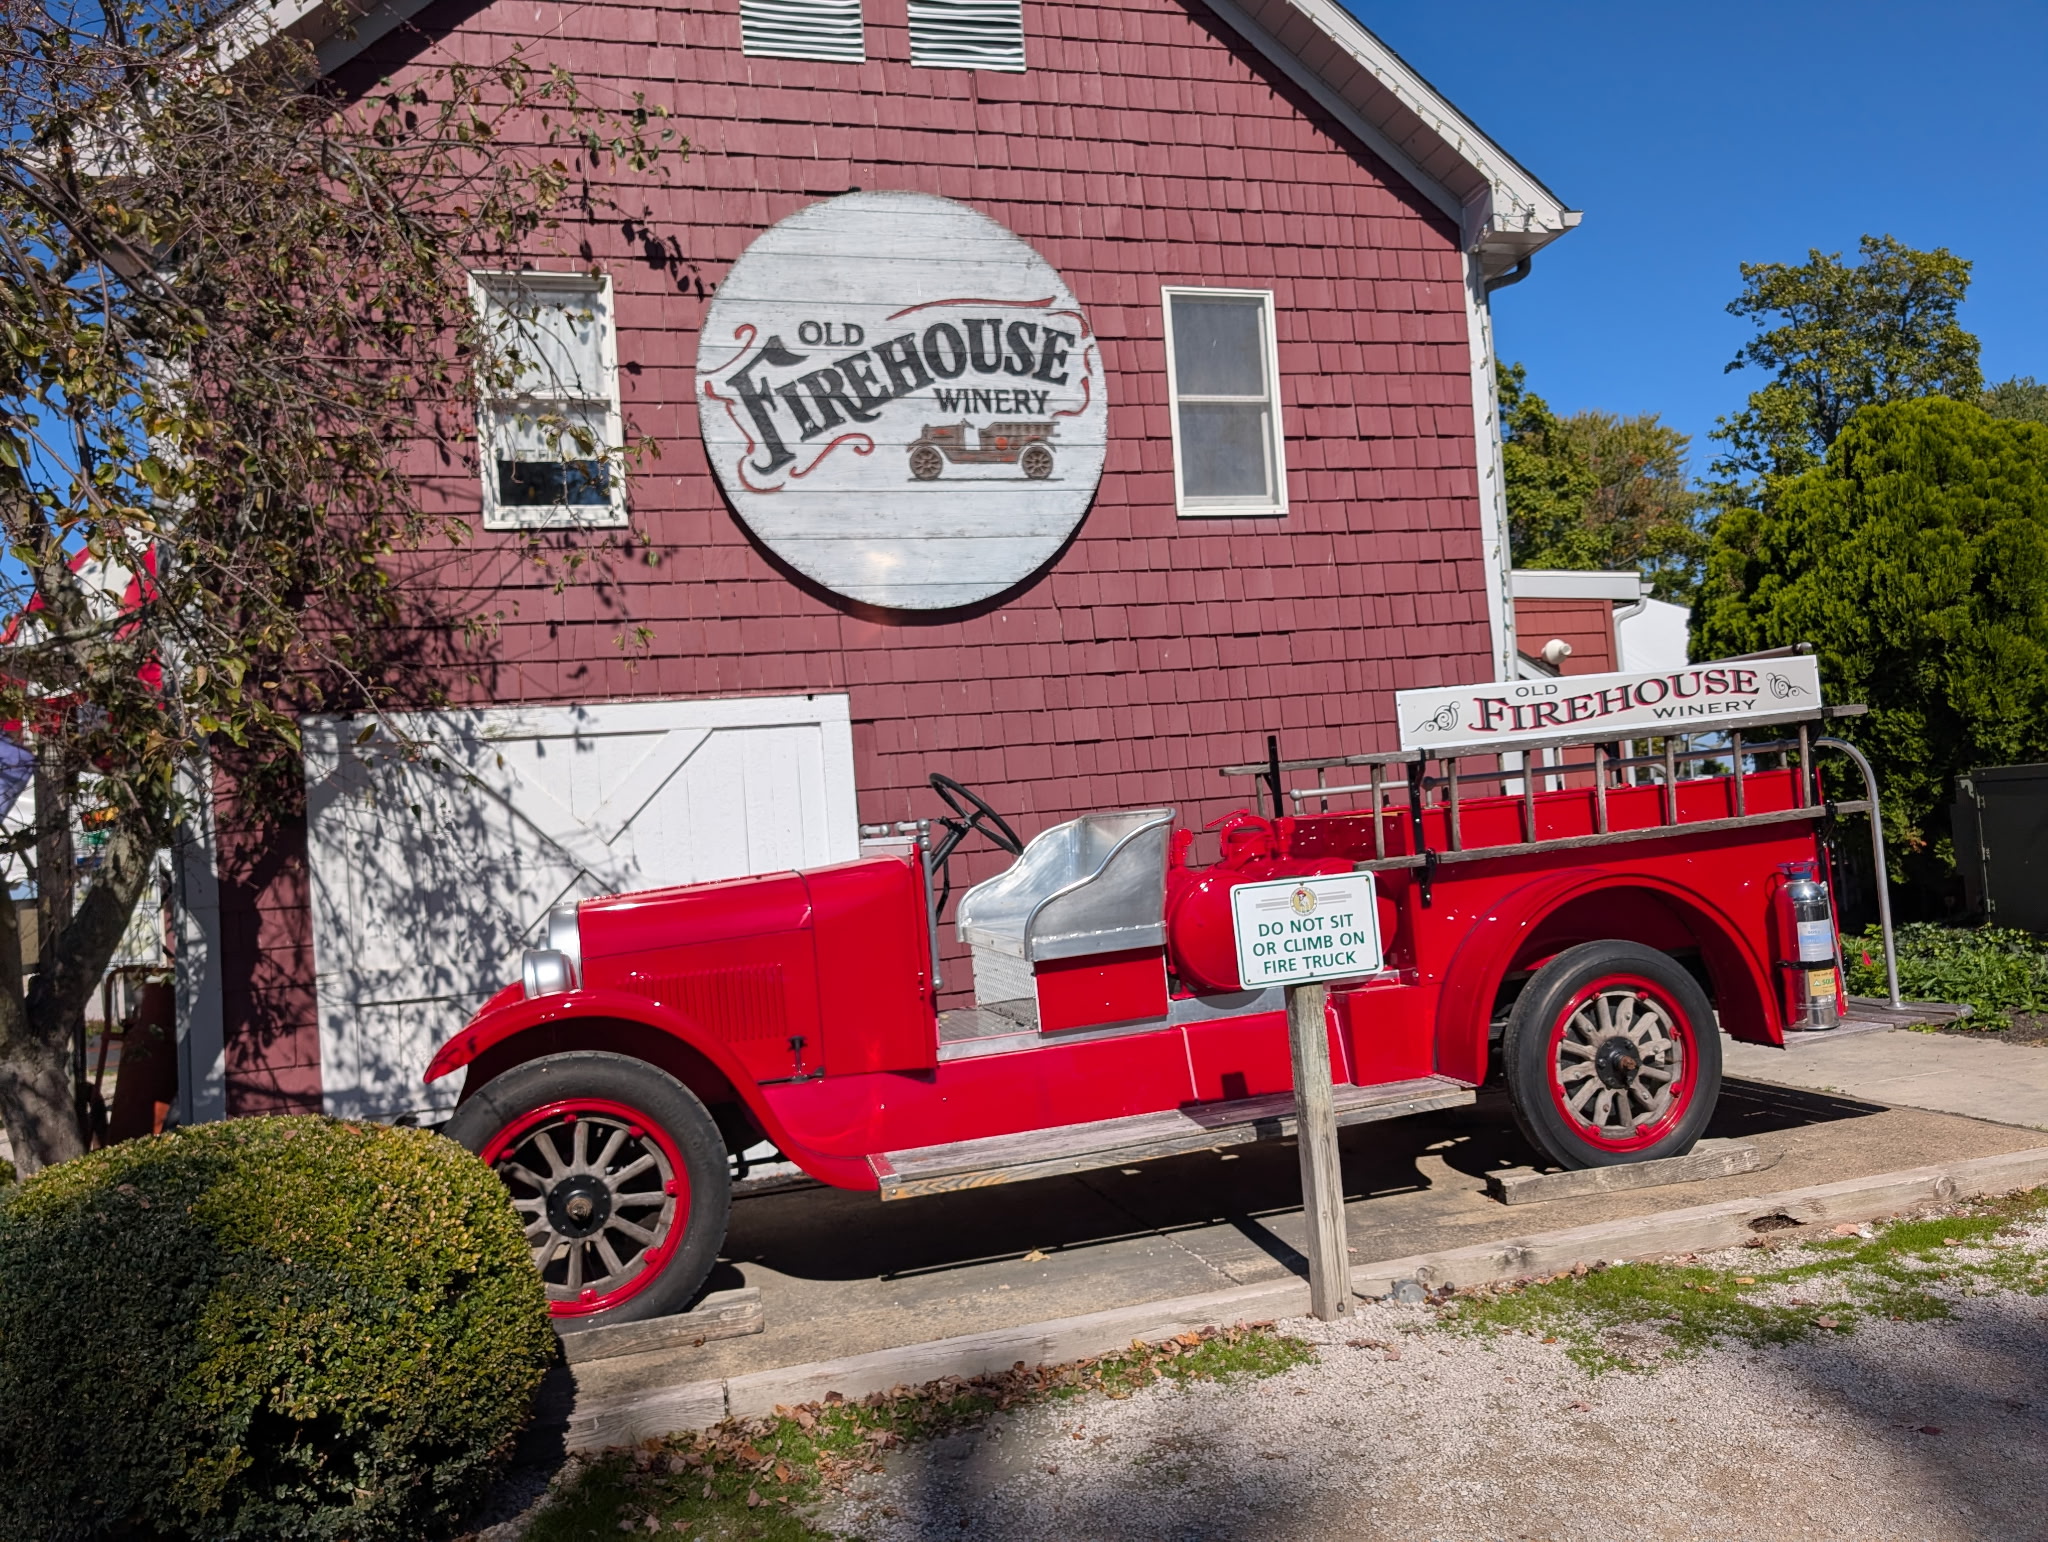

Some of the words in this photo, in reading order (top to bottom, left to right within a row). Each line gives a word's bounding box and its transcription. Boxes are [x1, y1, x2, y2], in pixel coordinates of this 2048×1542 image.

[798, 320, 865, 347] OLD
[725, 318, 1076, 475] FIREHOUSE
[933, 387, 1051, 415] WINERY
[1467, 668, 1761, 733] FIREHOUSE
[1515, 683, 1558, 698] OLD
[1653, 699, 1757, 719] WINERY
[1258, 921, 1284, 937] DO
[1290, 916, 1325, 933] NOT
[1330, 913, 1354, 929] SIT
[1252, 941, 1277, 957] OR
[1283, 935, 1334, 953] CLIMB
[1339, 931, 1365, 946] ON
[1263, 957, 1298, 975] FIRE
[1302, 951, 1357, 970] TRUCK
